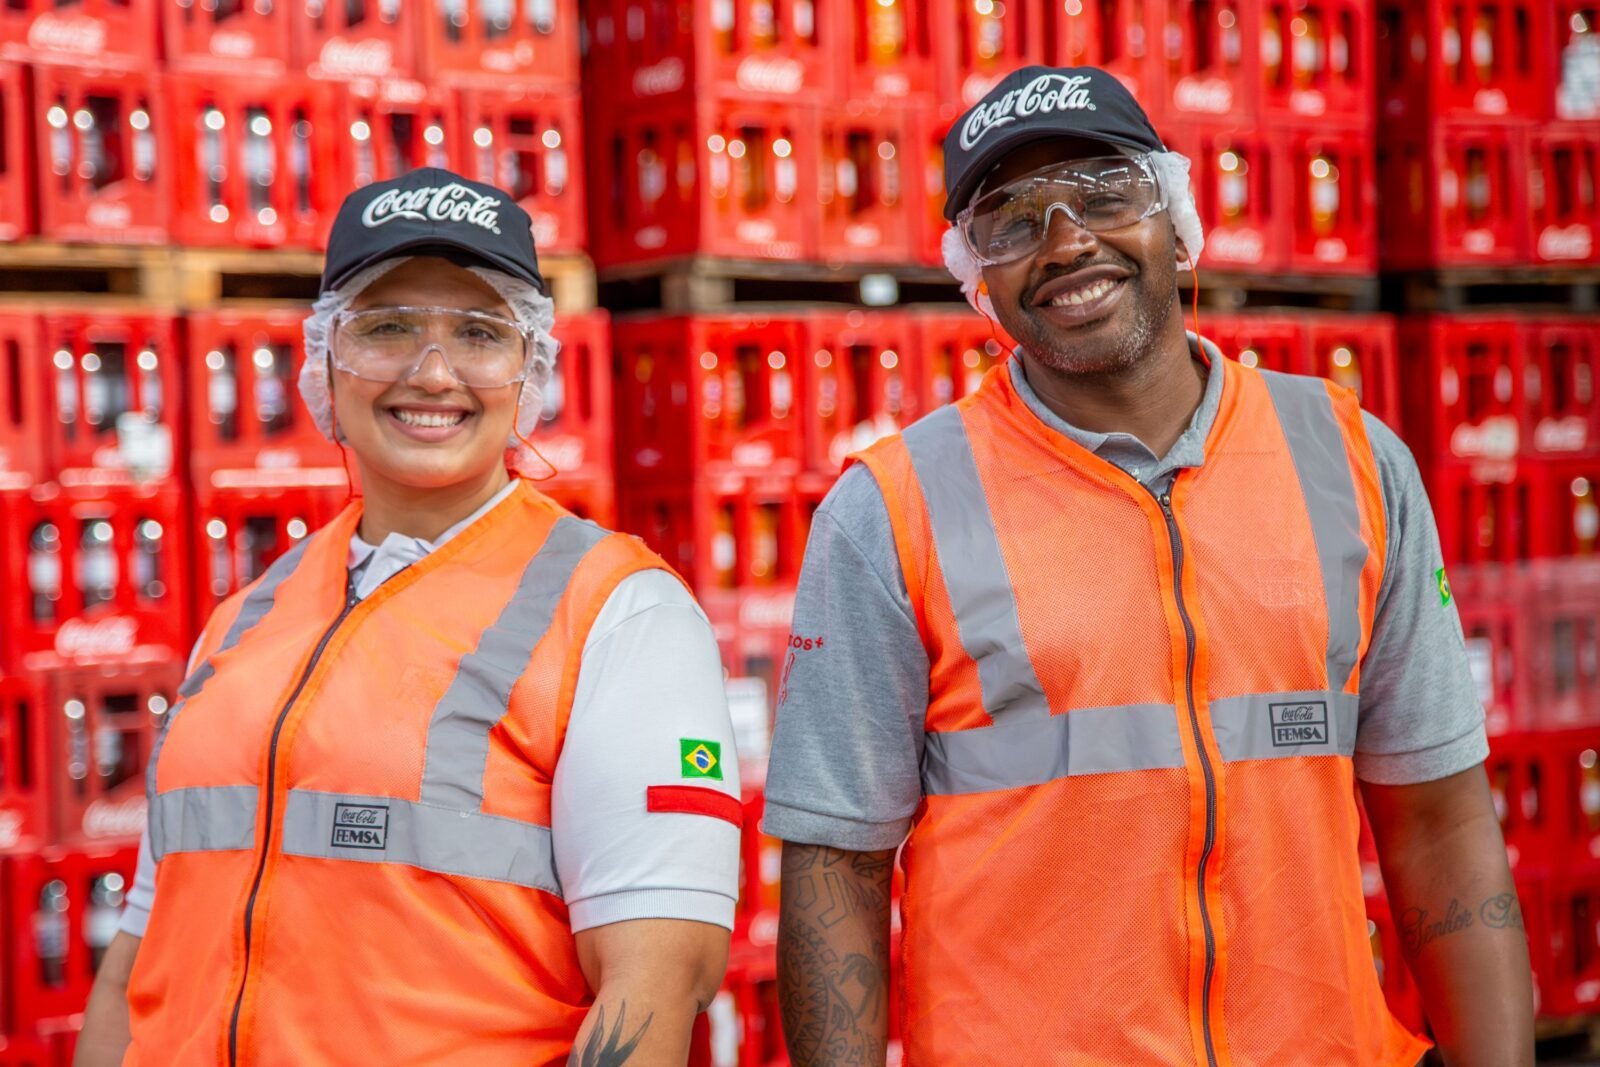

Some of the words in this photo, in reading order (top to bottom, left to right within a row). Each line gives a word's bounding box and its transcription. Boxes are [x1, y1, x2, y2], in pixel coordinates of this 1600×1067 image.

[959, 74, 1092, 151] Coca-Cola
[361, 182, 501, 230] Coca-Cola
[1277, 727, 1323, 742] FEMSA
[336, 829, 381, 845] FEMSA
